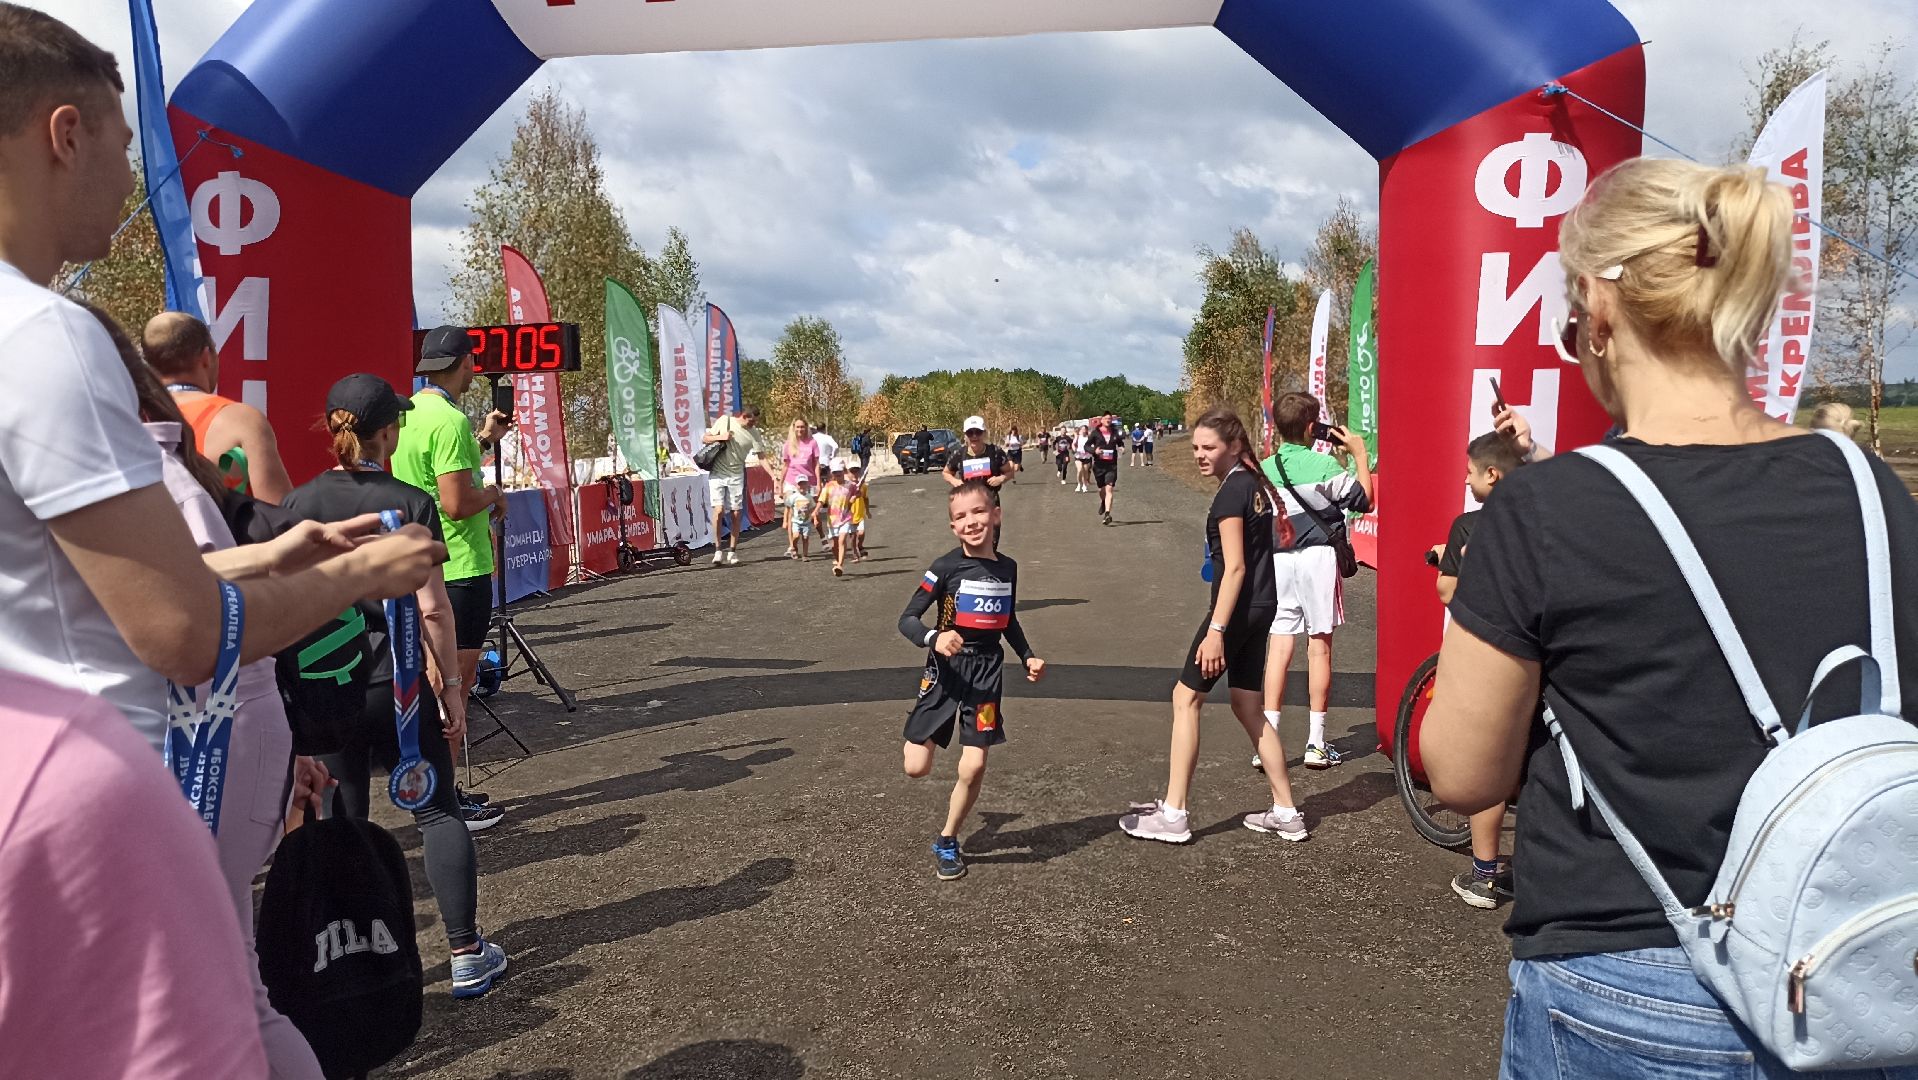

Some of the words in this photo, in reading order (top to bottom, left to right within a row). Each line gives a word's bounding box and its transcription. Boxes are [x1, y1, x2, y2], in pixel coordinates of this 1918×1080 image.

[1464, 132, 1588, 513] ФИН
[972, 597, 1002, 613] 266
[405, 606, 415, 670] #БОКСЗАБЕГ
